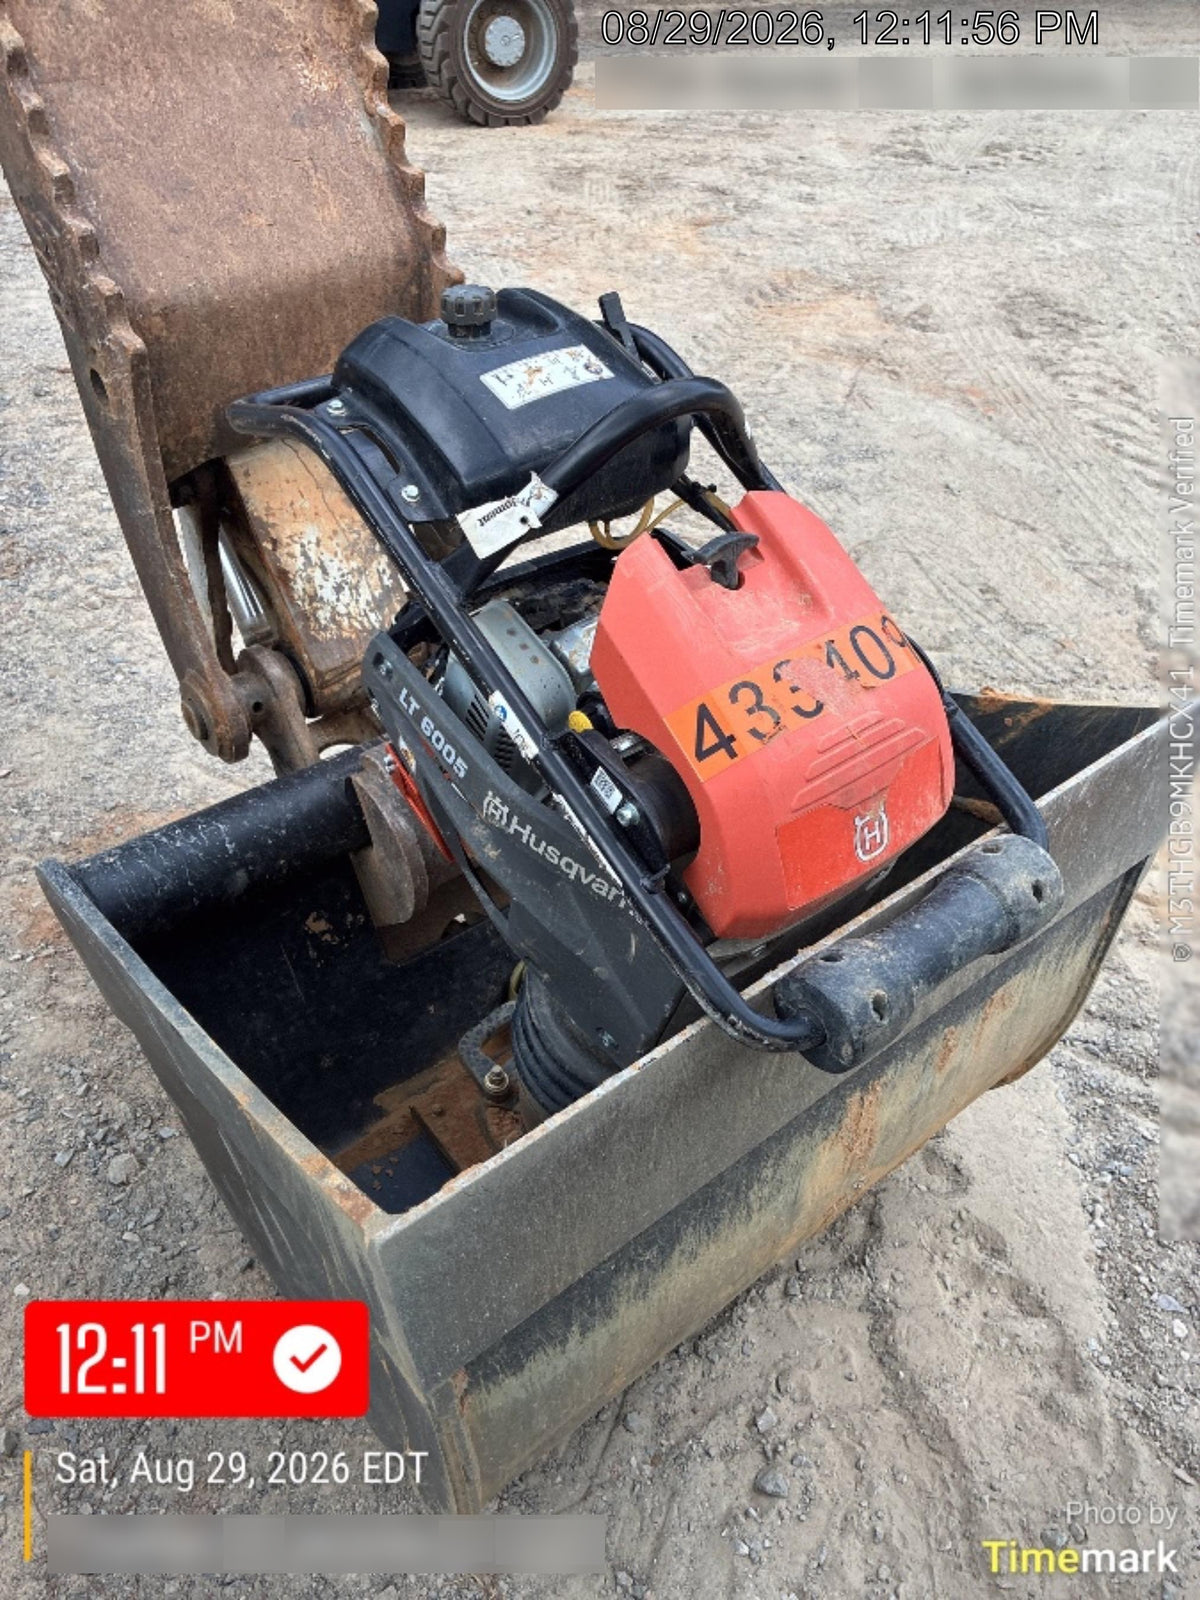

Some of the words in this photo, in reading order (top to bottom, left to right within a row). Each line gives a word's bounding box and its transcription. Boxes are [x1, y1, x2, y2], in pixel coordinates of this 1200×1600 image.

[399, 687, 421, 716] LT
[421, 716, 468, 778] 6005
[507, 815, 634, 912] Husqvar
